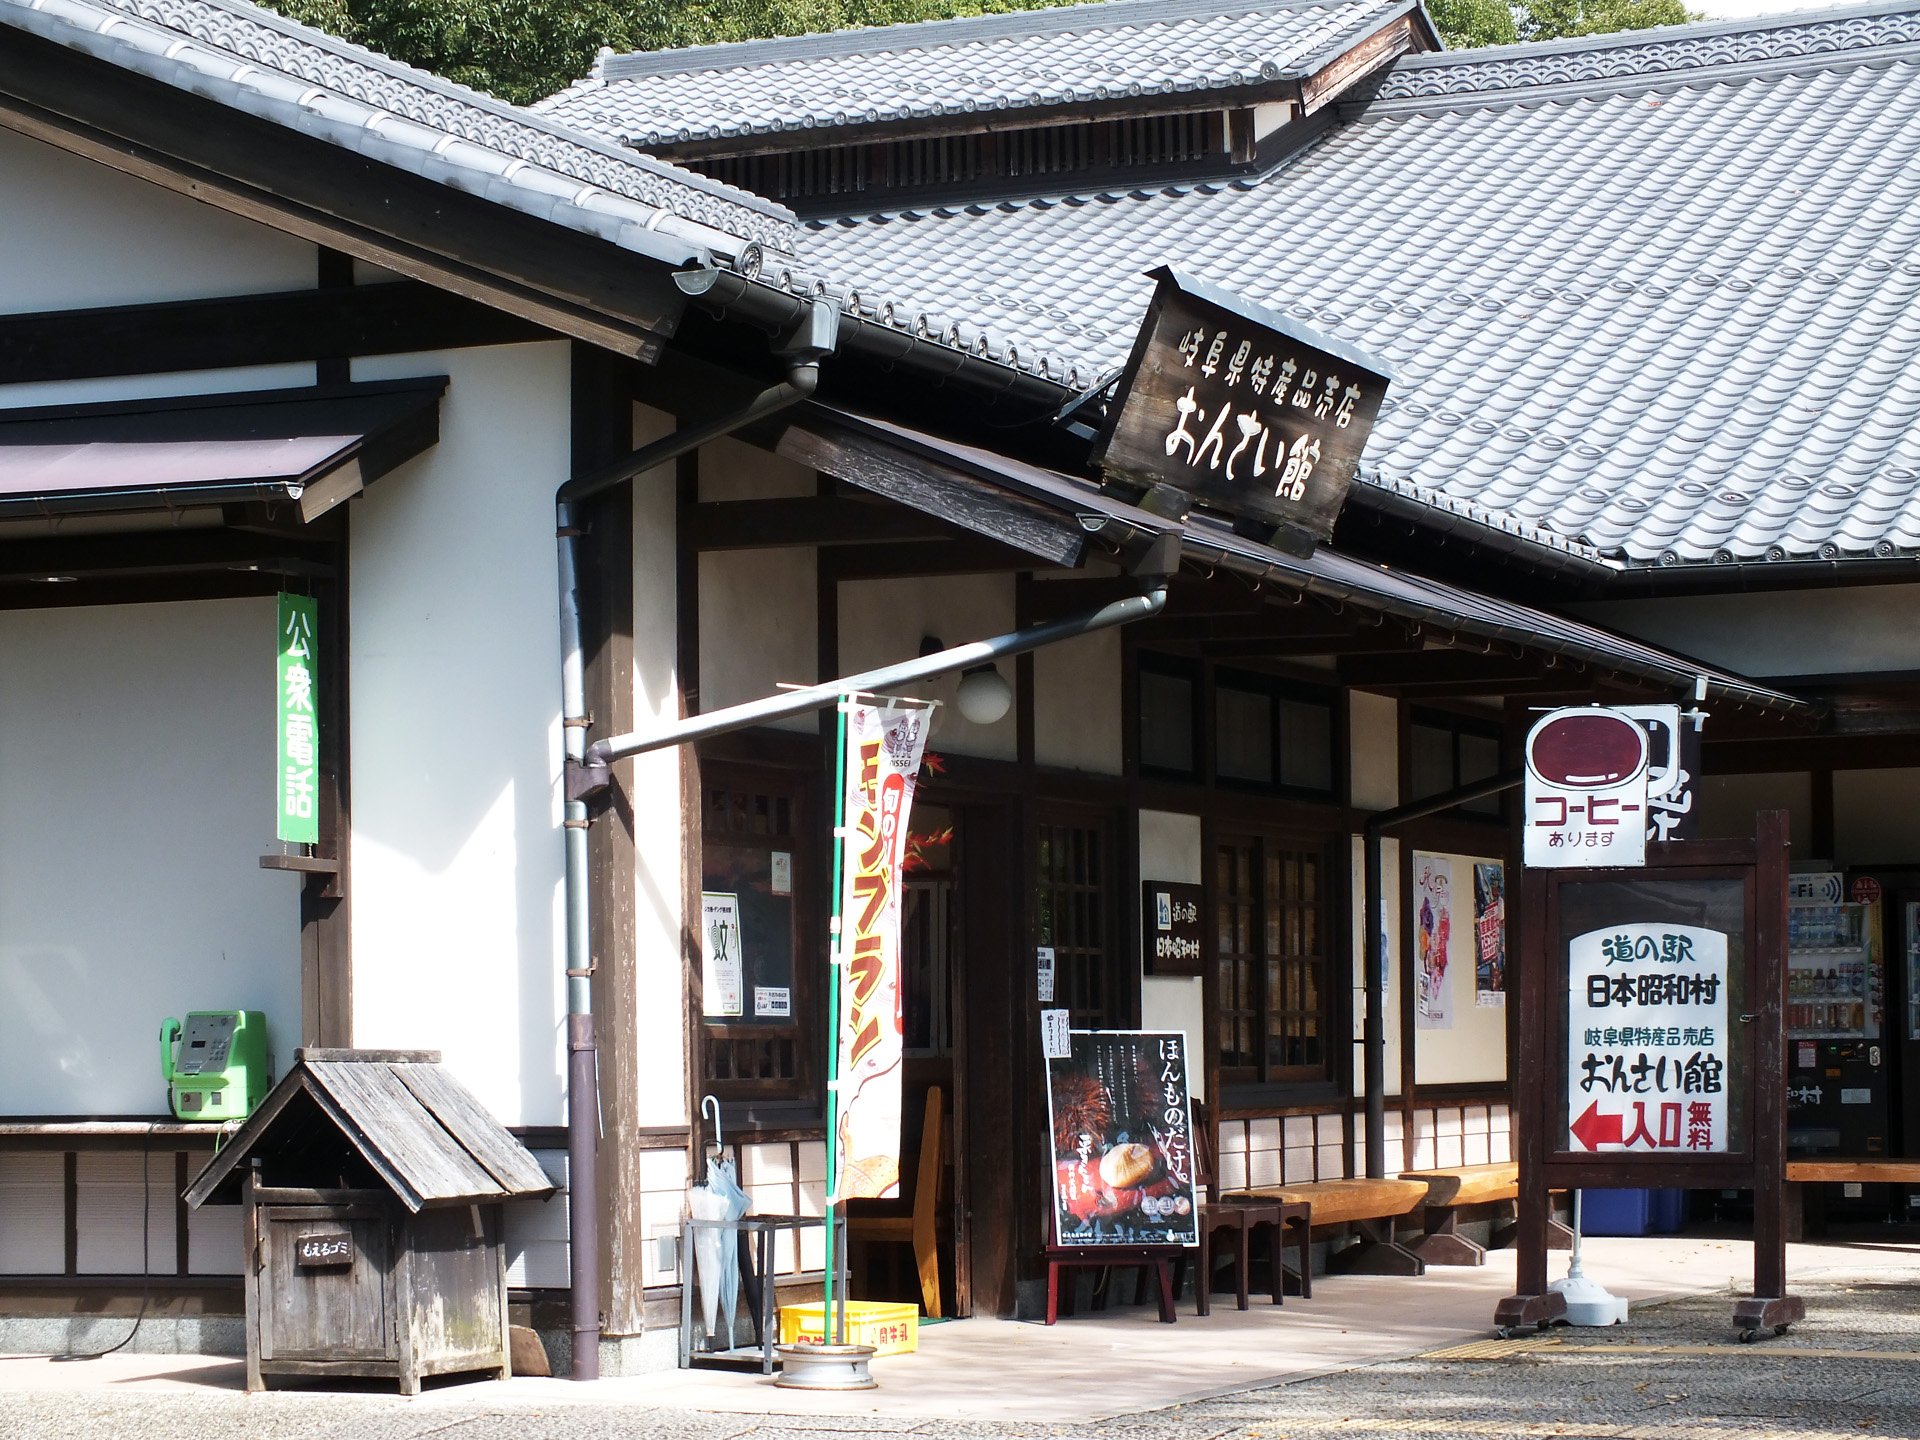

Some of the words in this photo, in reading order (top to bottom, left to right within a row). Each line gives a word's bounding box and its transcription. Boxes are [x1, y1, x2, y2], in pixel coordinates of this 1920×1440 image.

[1178, 327, 1361, 429] 岐阜県特産品売店
[1165, 385, 1321, 501] おんさい館
[284, 610, 314, 819] 公衆電話
[1534, 795, 1640, 826] コーヒー
[1549, 831, 1615, 848] あります
[1172, 901, 1198, 923] 道の駅
[1156, 935, 1200, 959] 日本昭和村
[1601, 933, 1697, 967] 道の駅
[1587, 972, 1721, 1008] 日本昭和村
[1584, 1026, 1715, 1047] 岐阜県特産品売店
[1579, 1051, 1724, 1095] おんさい館
[1158, 1038, 1190, 1184] ほんものだけ。
[1623, 1101, 1683, 1150] 入口
[1687, 1101, 1714, 1151] 無料
[302, 1241, 348, 1258] もえるゴミ
